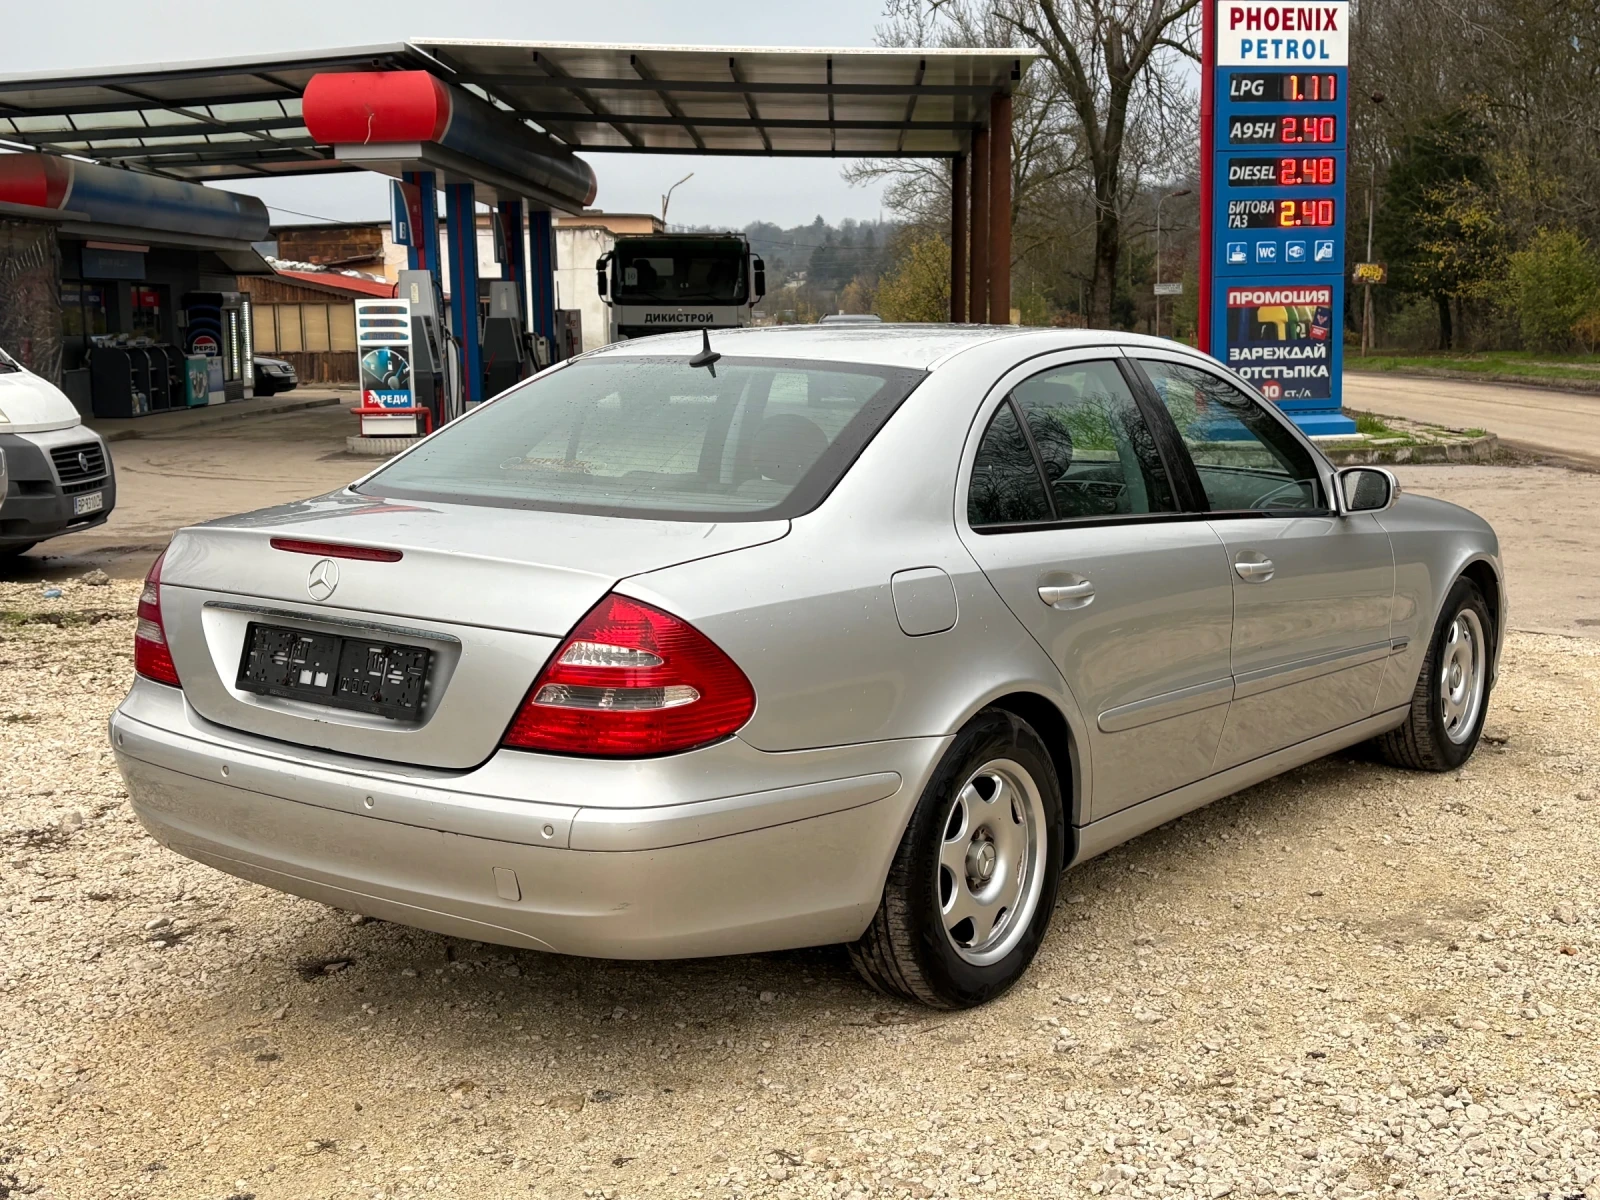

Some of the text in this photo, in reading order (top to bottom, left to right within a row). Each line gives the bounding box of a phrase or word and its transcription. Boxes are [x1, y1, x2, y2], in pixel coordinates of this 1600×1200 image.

[1230, 7, 1338, 31] PHOENIX
[1241, 39, 1329, 59] PETROL
[1230, 75, 1335, 100] LPG 1.11
[1230, 117, 1334, 142] A95H 2.40
[1229, 159, 1334, 184] DIESEL 2.48
[1228, 200, 1333, 226] БИТОВА 2.40
[1228, 215, 1249, 228] ГАЗ
[1259, 247, 1276, 258] WC
[1229, 290, 1329, 305] ПРОМОЦИЯ
[645, 312, 714, 323] ДИКИСТРОЙ
[1230, 343, 1326, 360] ЗАРЕЖДАЙ
[1240, 365, 1329, 379] ОТСТЪПКА
[367, 395, 408, 404] ЗАРЕДИ
